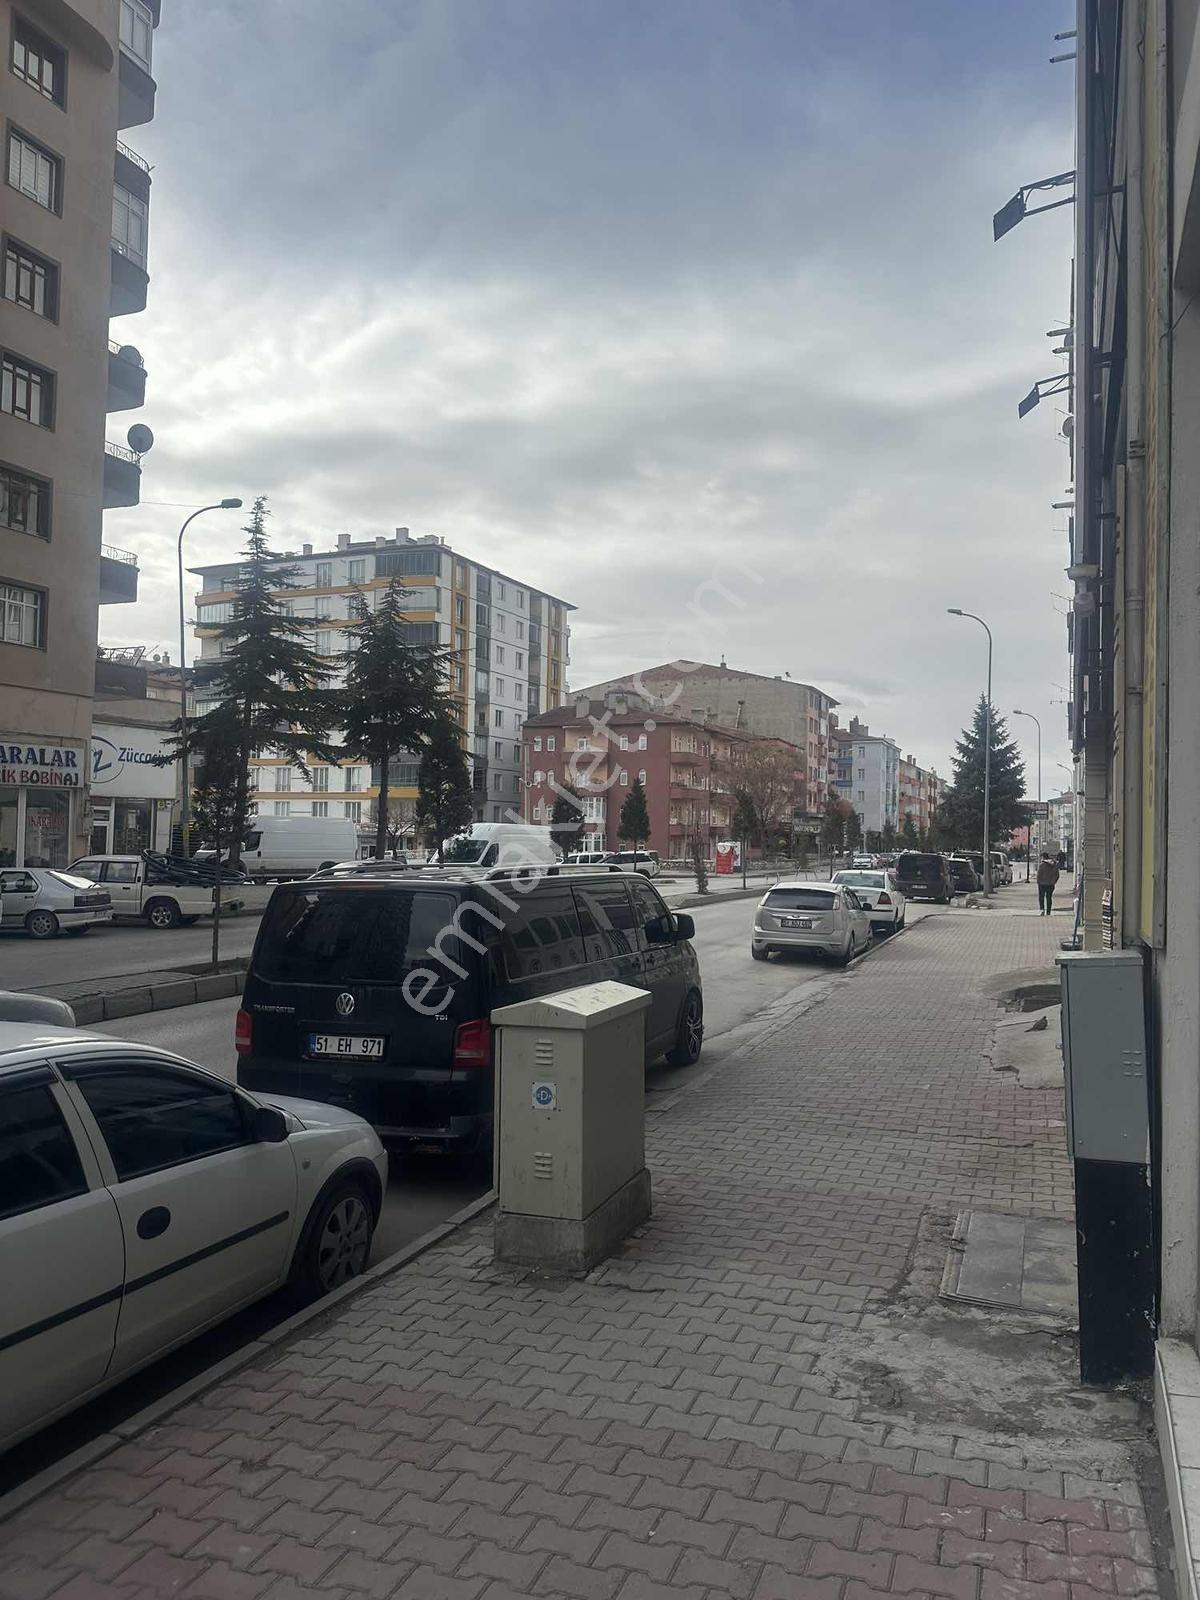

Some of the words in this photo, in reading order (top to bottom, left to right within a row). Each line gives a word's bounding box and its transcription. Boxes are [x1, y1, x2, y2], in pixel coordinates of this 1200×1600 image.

[0, 765, 16, 783] İK
[20, 767, 79, 786] BOBİNAJ
[316, 1036, 328, 1052] 51
[338, 1038, 352, 1053] EH
[361, 1039, 382, 1055] 971
